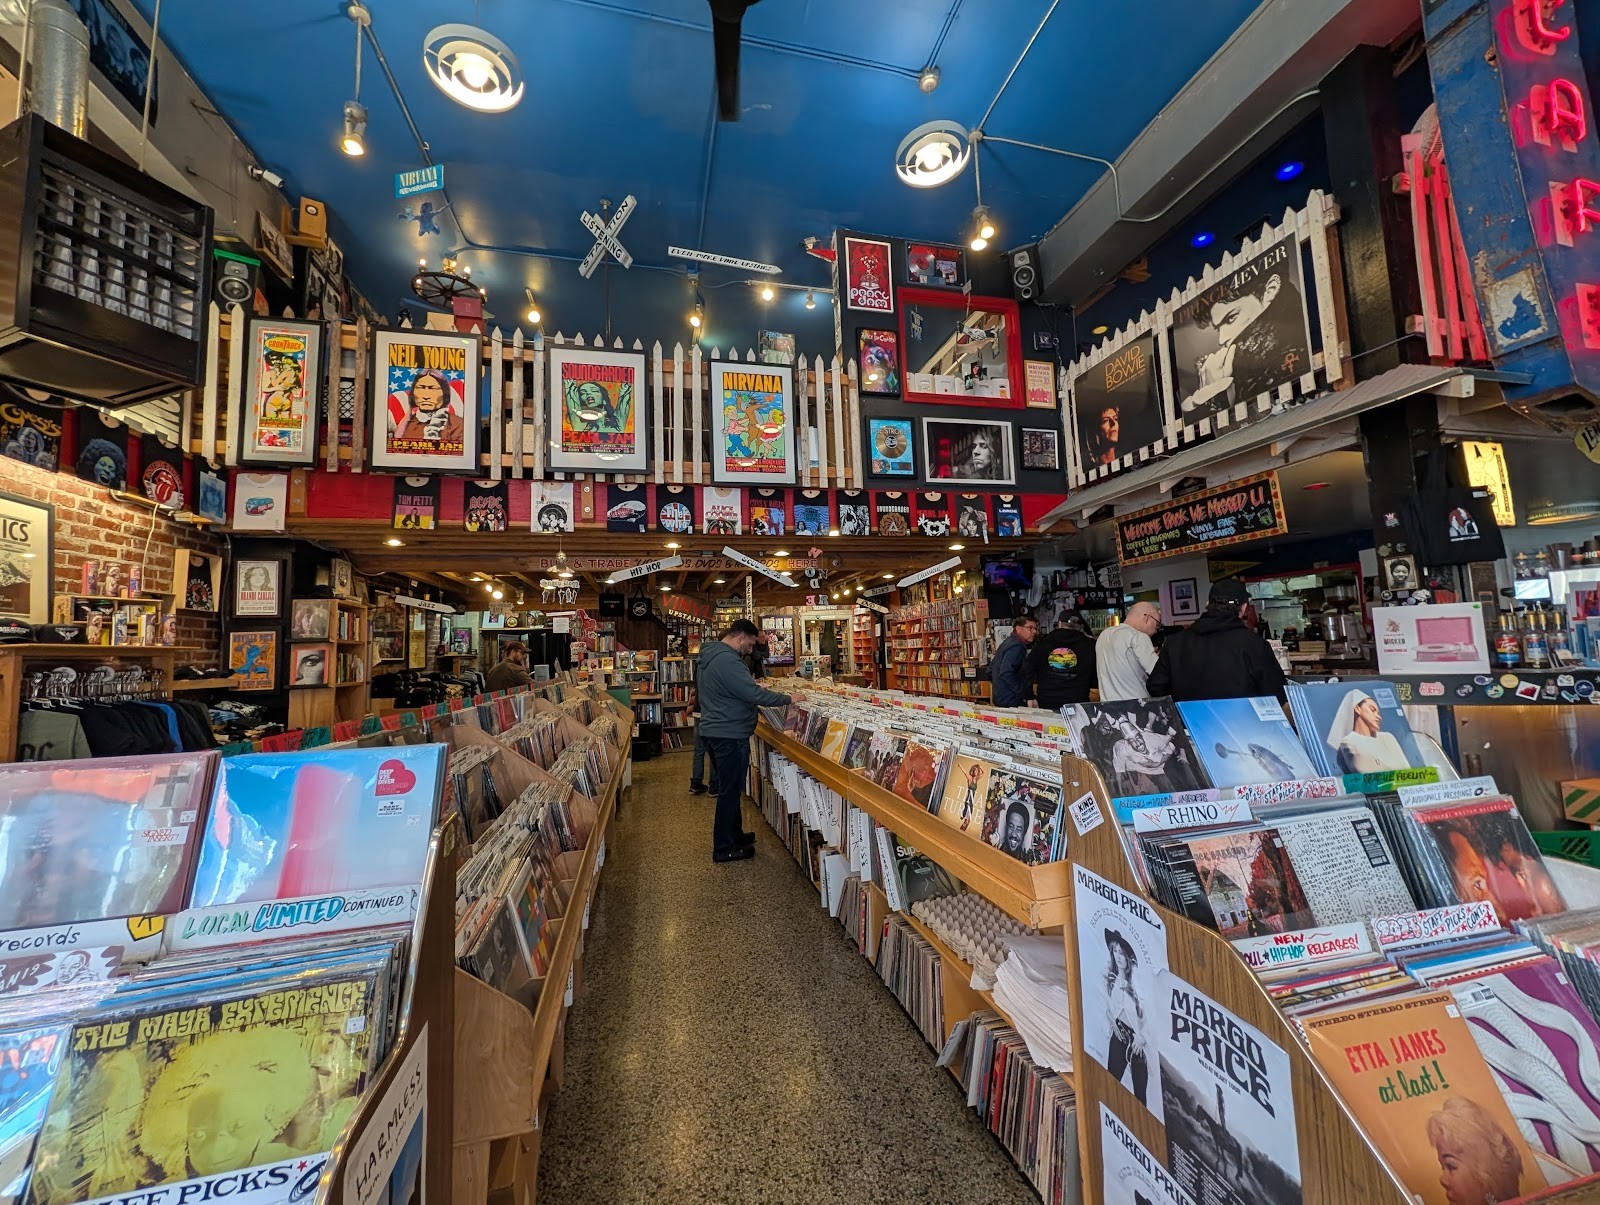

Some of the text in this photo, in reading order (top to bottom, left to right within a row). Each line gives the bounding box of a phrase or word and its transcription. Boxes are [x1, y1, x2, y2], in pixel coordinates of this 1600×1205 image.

[400, 166, 437, 187] NIRVANA
[581, 213, 623, 259] LISTENING
[671, 248, 693, 258] EVEN
[1229, 245, 1288, 291] 4EVER
[389, 343, 465, 371] NEIL YOUNG
[1105, 345, 1141, 377] DAVID
[562, 363, 634, 383] SOUNDGARDEN
[723, 372, 782, 393] NIRVANA
[1105, 354, 1146, 389] BOWIE
[392, 440, 436, 451] PEARL
[438, 442, 464, 451] JAM
[562, 431, 635, 445] PEARL JAM
[398, 494, 434, 506] TOM PETTY
[469, 495, 503, 509] AC/DC
[876, 505, 910, 513] SOUNDGARDEN
[1123, 517, 1162, 541] WELCOME
[1163, 508, 1190, 530] BACK
[1189, 503, 1208, 523] WE
[1207, 492, 1248, 518] MISSED
[1191, 515, 1238, 535] VINYL BAR
[573, 559, 583, 569] &
[587, 559, 630, 569] TRADE
[787, 559, 818, 569] HERE
[630, 562, 662, 577] HIP HOP
[417, 600, 436, 609] Jazz
[668, 609, 707, 625] UPSTAIRS
[1025, 768, 1060, 782] WITHERS
[1264, 782, 1283, 804] STAFF
[1278, 783, 1296, 801] PICKS
[1077, 797, 1094, 812] KIND
[1166, 804, 1218, 825] RHINO
[1077, 870, 1119, 906] MARGO
[181, 895, 404, 940] LOCAL LIMITED CONTINUED.
[1422, 910, 1444, 935] STAFF
[1445, 908, 1466, 931] PICKS
[0, 926, 80, 951] records
[1274, 932, 1305, 945] NEW
[1306, 933, 1360, 957] RELEASES!
[74, 981, 367, 1052] THE MAYA EXPERIENCE
[1309, 994, 1450, 1028] STEREO STEREO STEREO
[1171, 988, 1268, 1077] MARGO
[1345, 1029, 1448, 1074] ETTA JAMES
[1170, 1012, 1276, 1119] PRICE
[1213, 1070, 1229, 1085] HEART
[1378, 1060, 1450, 1104] at last!
[1104, 1111, 1152, 1175] MARGO
[176, 1164, 294, 1205] PICKS
